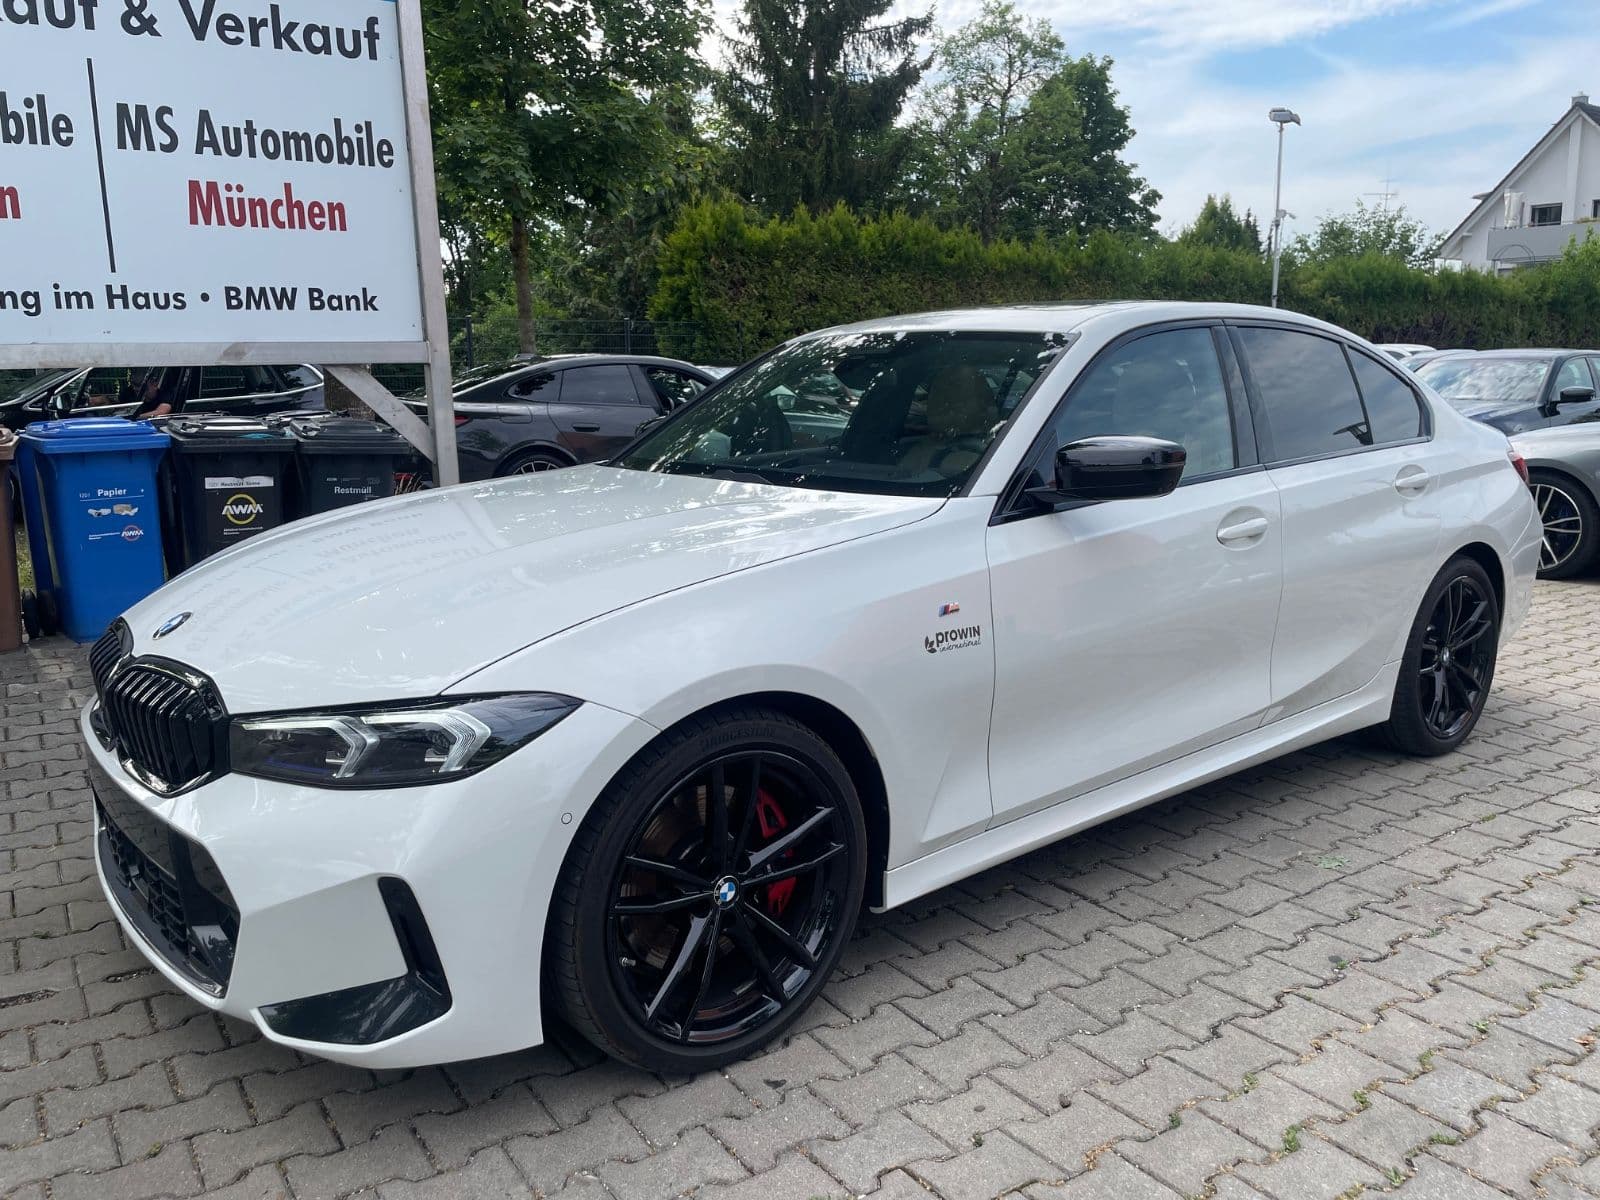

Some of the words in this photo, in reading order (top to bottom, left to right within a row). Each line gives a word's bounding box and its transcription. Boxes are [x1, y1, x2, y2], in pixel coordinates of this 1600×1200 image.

[0, 0, 98, 31] auf
[120, 0, 162, 38] &
[178, 0, 380, 61] Verkauf
[116, 102, 179, 154] MS
[194, 109, 394, 169] Automobile
[188, 179, 348, 232] München
[52, 282, 95, 310] im
[105, 284, 187, 311] Haus
[224, 285, 298, 311] BMW
[307, 287, 379, 312] Bank
[97, 487, 127, 498] Papier
[221, 503, 264, 515] AWM
